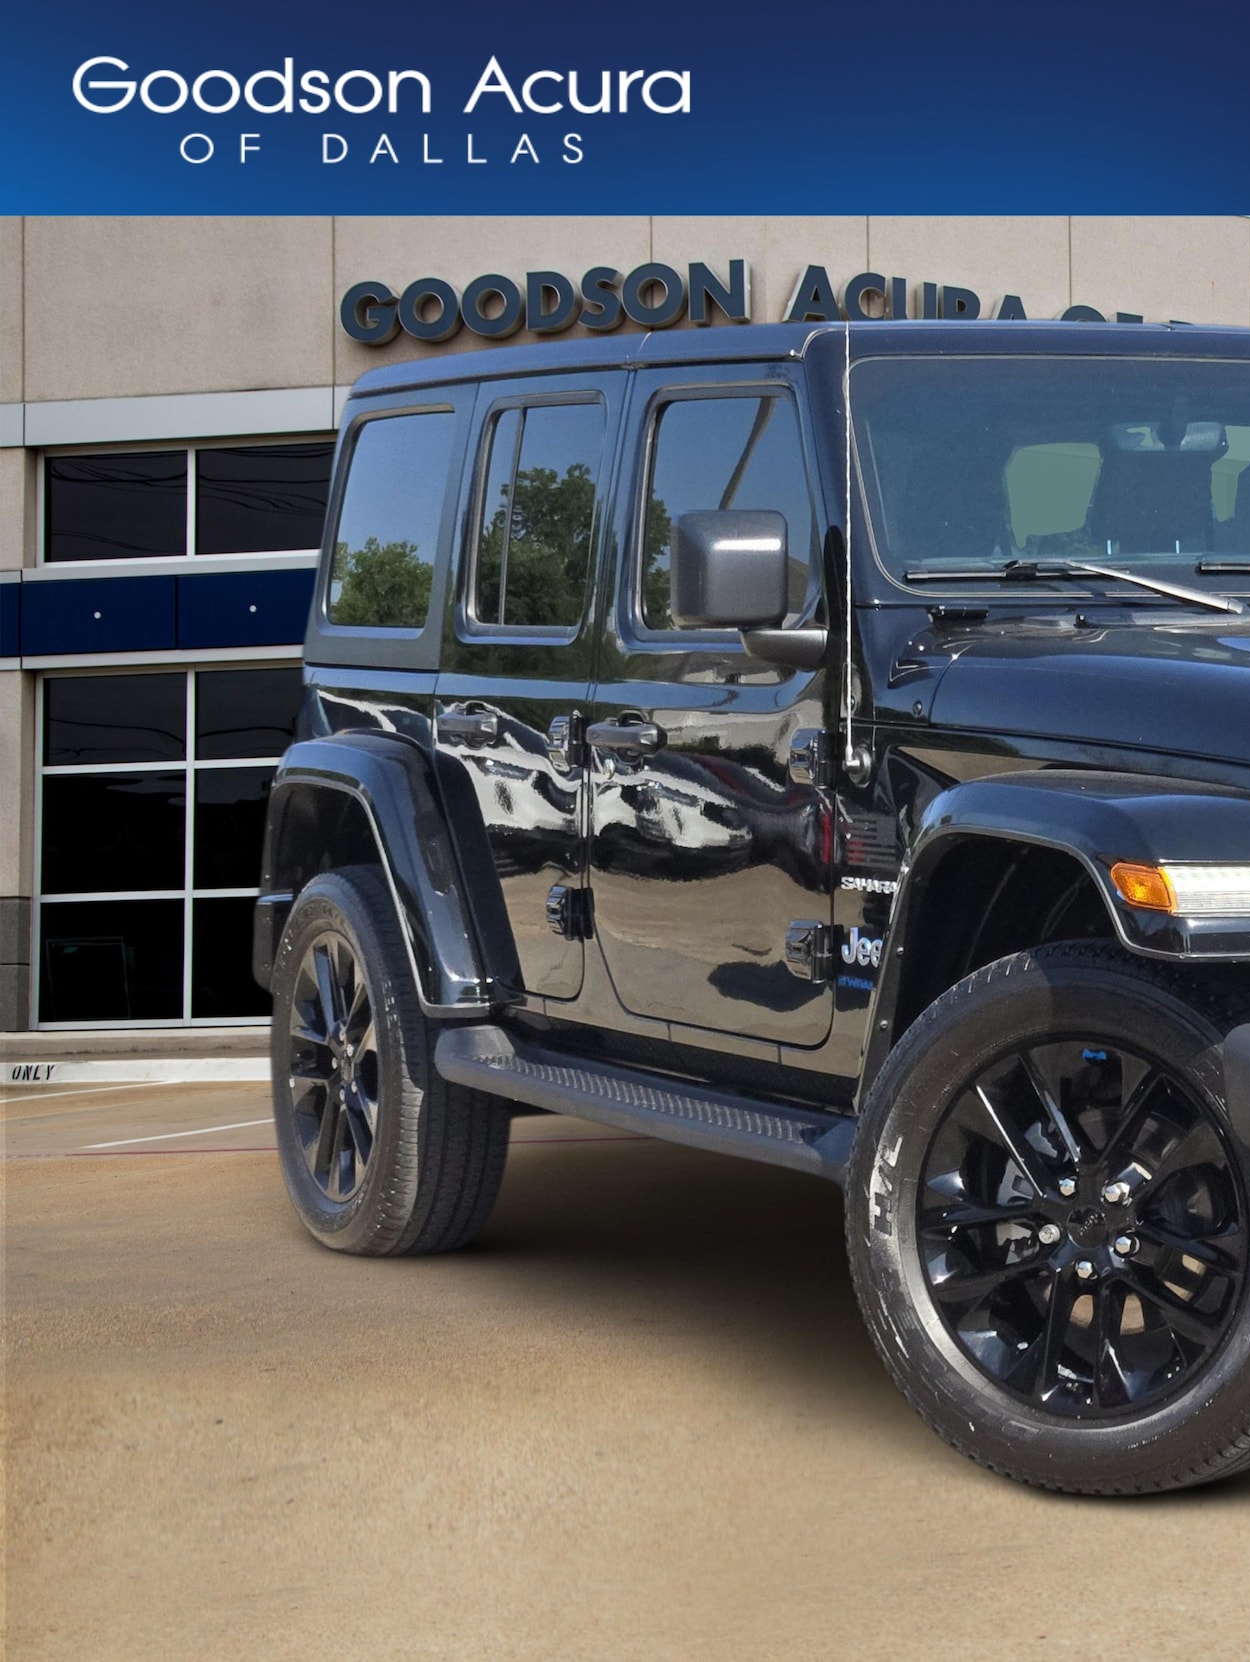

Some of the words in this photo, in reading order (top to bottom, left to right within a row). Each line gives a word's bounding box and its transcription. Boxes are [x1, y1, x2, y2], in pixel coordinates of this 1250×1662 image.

[340, 258, 751, 346] GOODSON
[841, 876, 898, 894] SAHARA
[841, 927, 884, 968] Jee
[11, 1064, 55, 1081] ONLY
